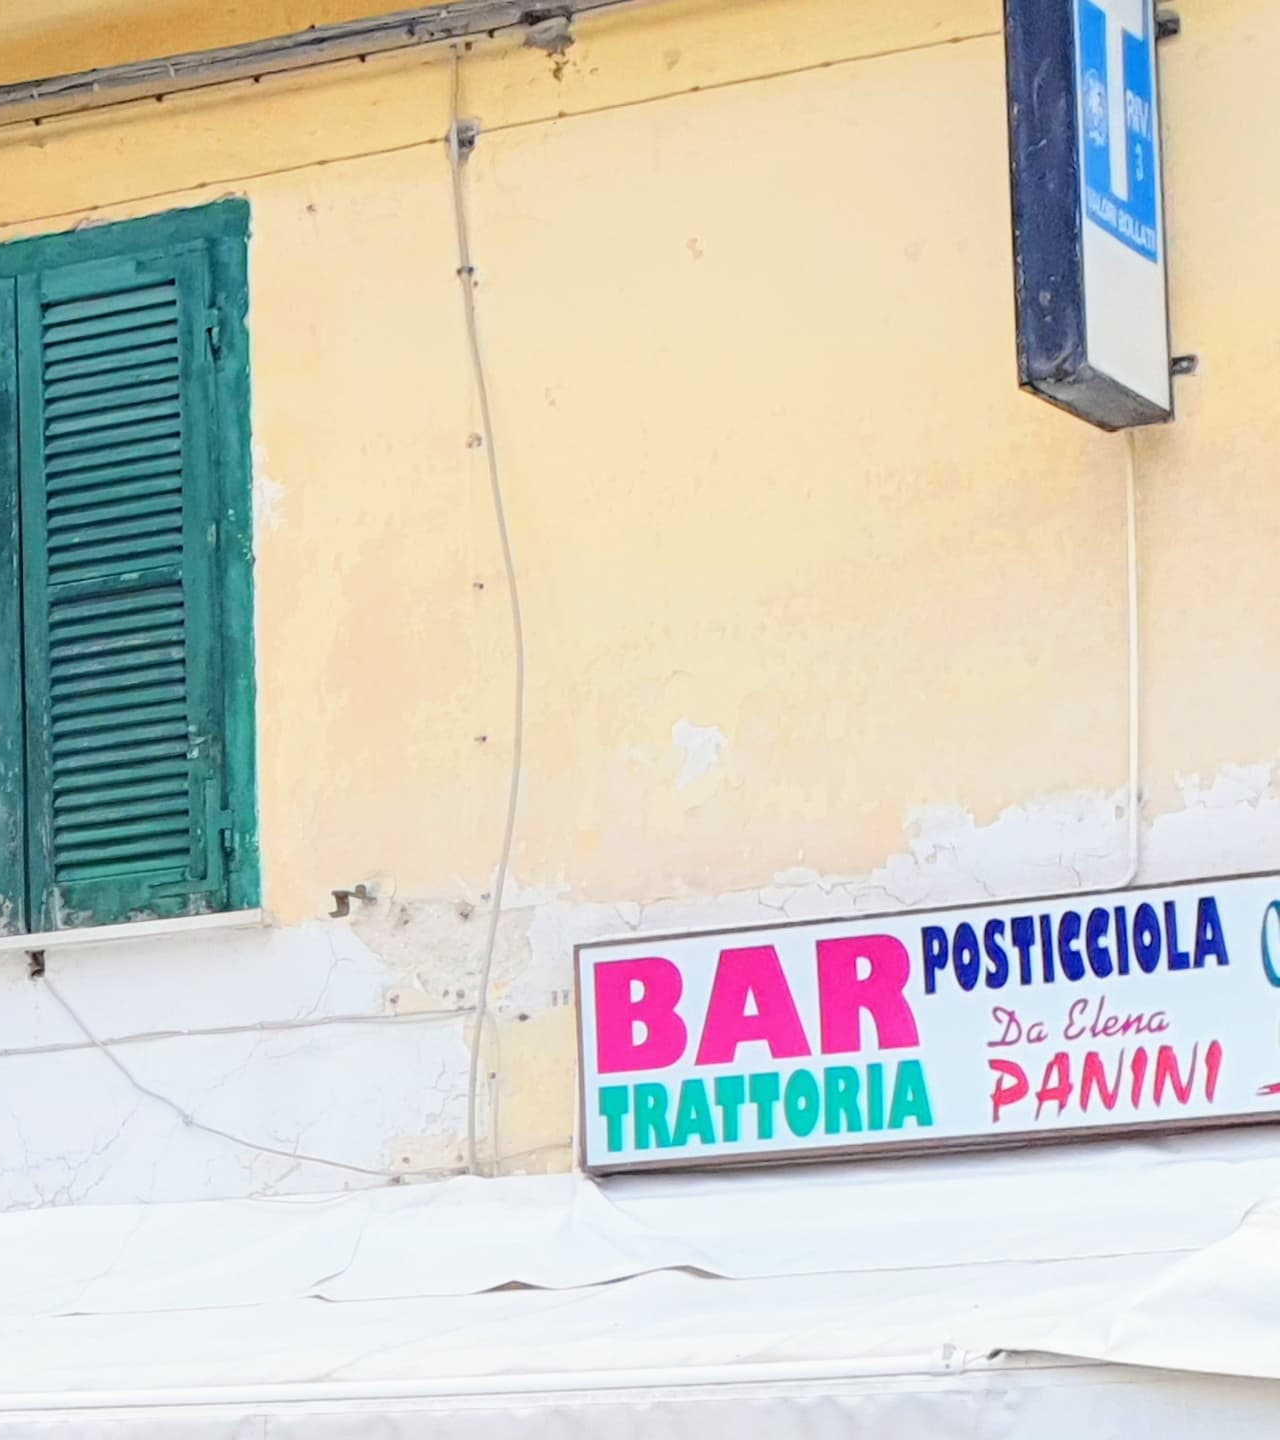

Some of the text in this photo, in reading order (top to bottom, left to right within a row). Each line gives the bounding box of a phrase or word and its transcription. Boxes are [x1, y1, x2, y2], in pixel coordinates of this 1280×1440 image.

[921, 896, 1230, 995] POSTICCIOLA
[593, 933, 921, 1074] BAR
[986, 995, 1170, 1048] Da Elena
[597, 1058, 934, 1153] TRATTORIA
[987, 1039, 1224, 1123] PANINI
